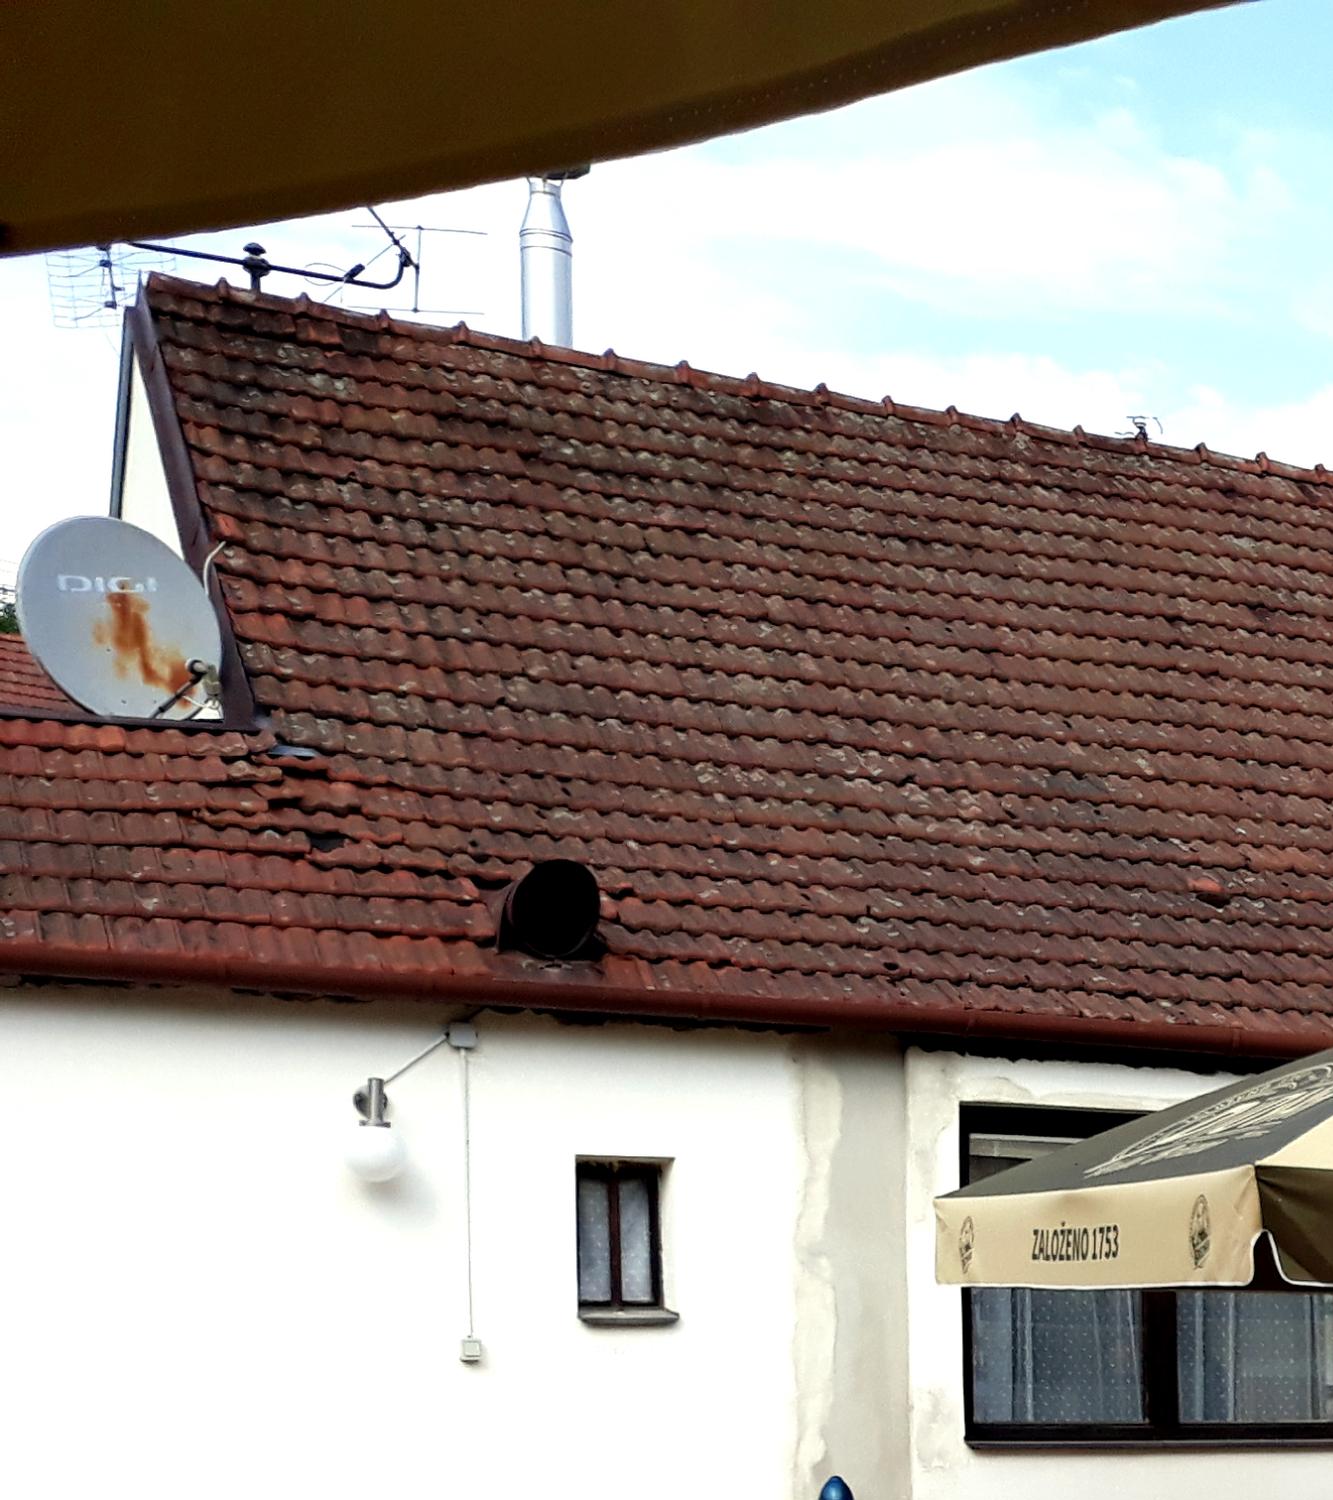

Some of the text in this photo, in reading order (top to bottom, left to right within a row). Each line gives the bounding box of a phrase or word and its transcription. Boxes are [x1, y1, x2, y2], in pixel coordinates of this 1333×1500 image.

[57, 574, 158, 593] DIGI
[1032, 1221, 1120, 1261] ZALOŽENO 1753
